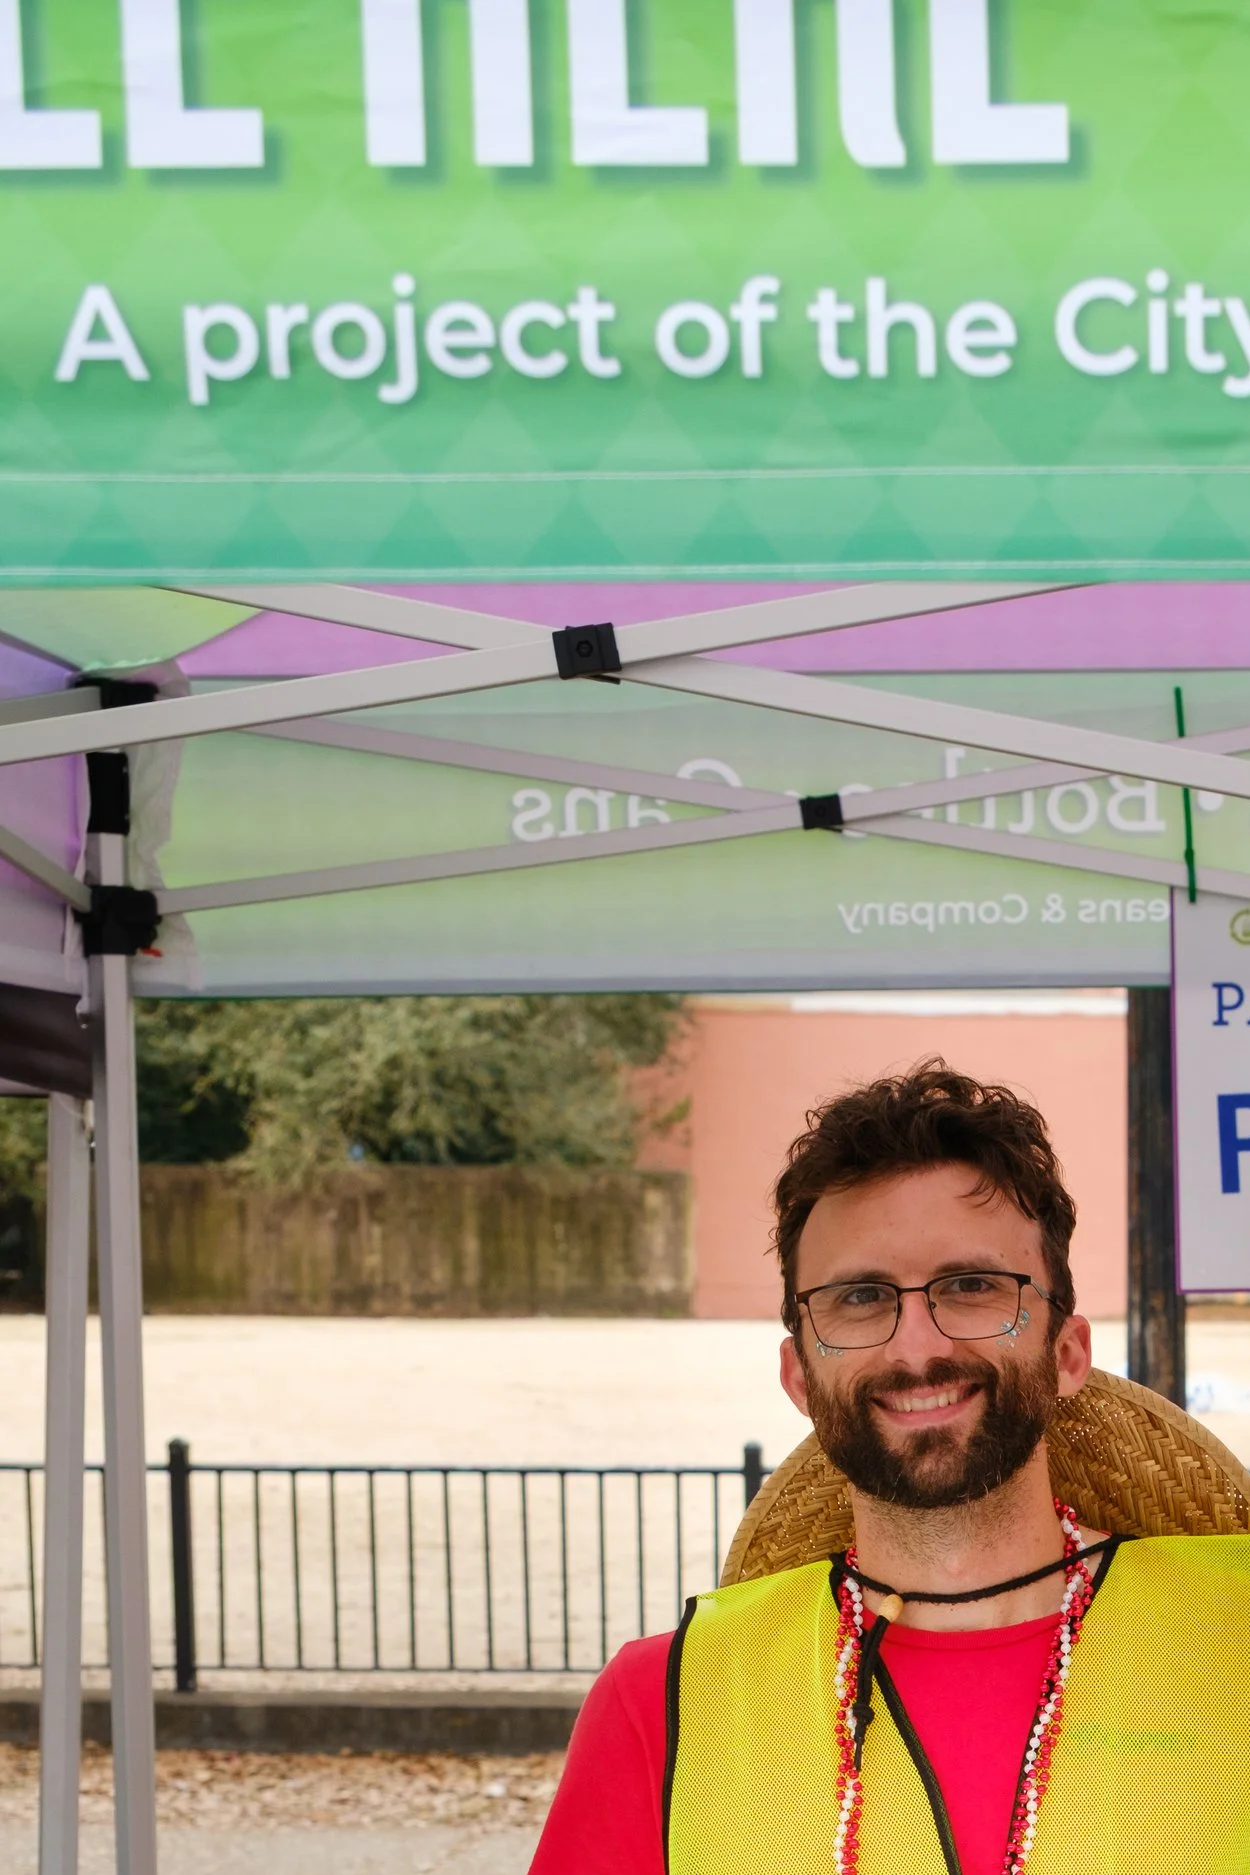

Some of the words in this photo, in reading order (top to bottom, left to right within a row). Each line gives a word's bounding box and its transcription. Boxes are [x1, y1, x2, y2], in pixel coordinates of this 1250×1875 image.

[54, 285, 149, 382] A
[183, 272, 620, 404] project
[655, 275, 782, 378] of
[809, 278, 1016, 378] the
